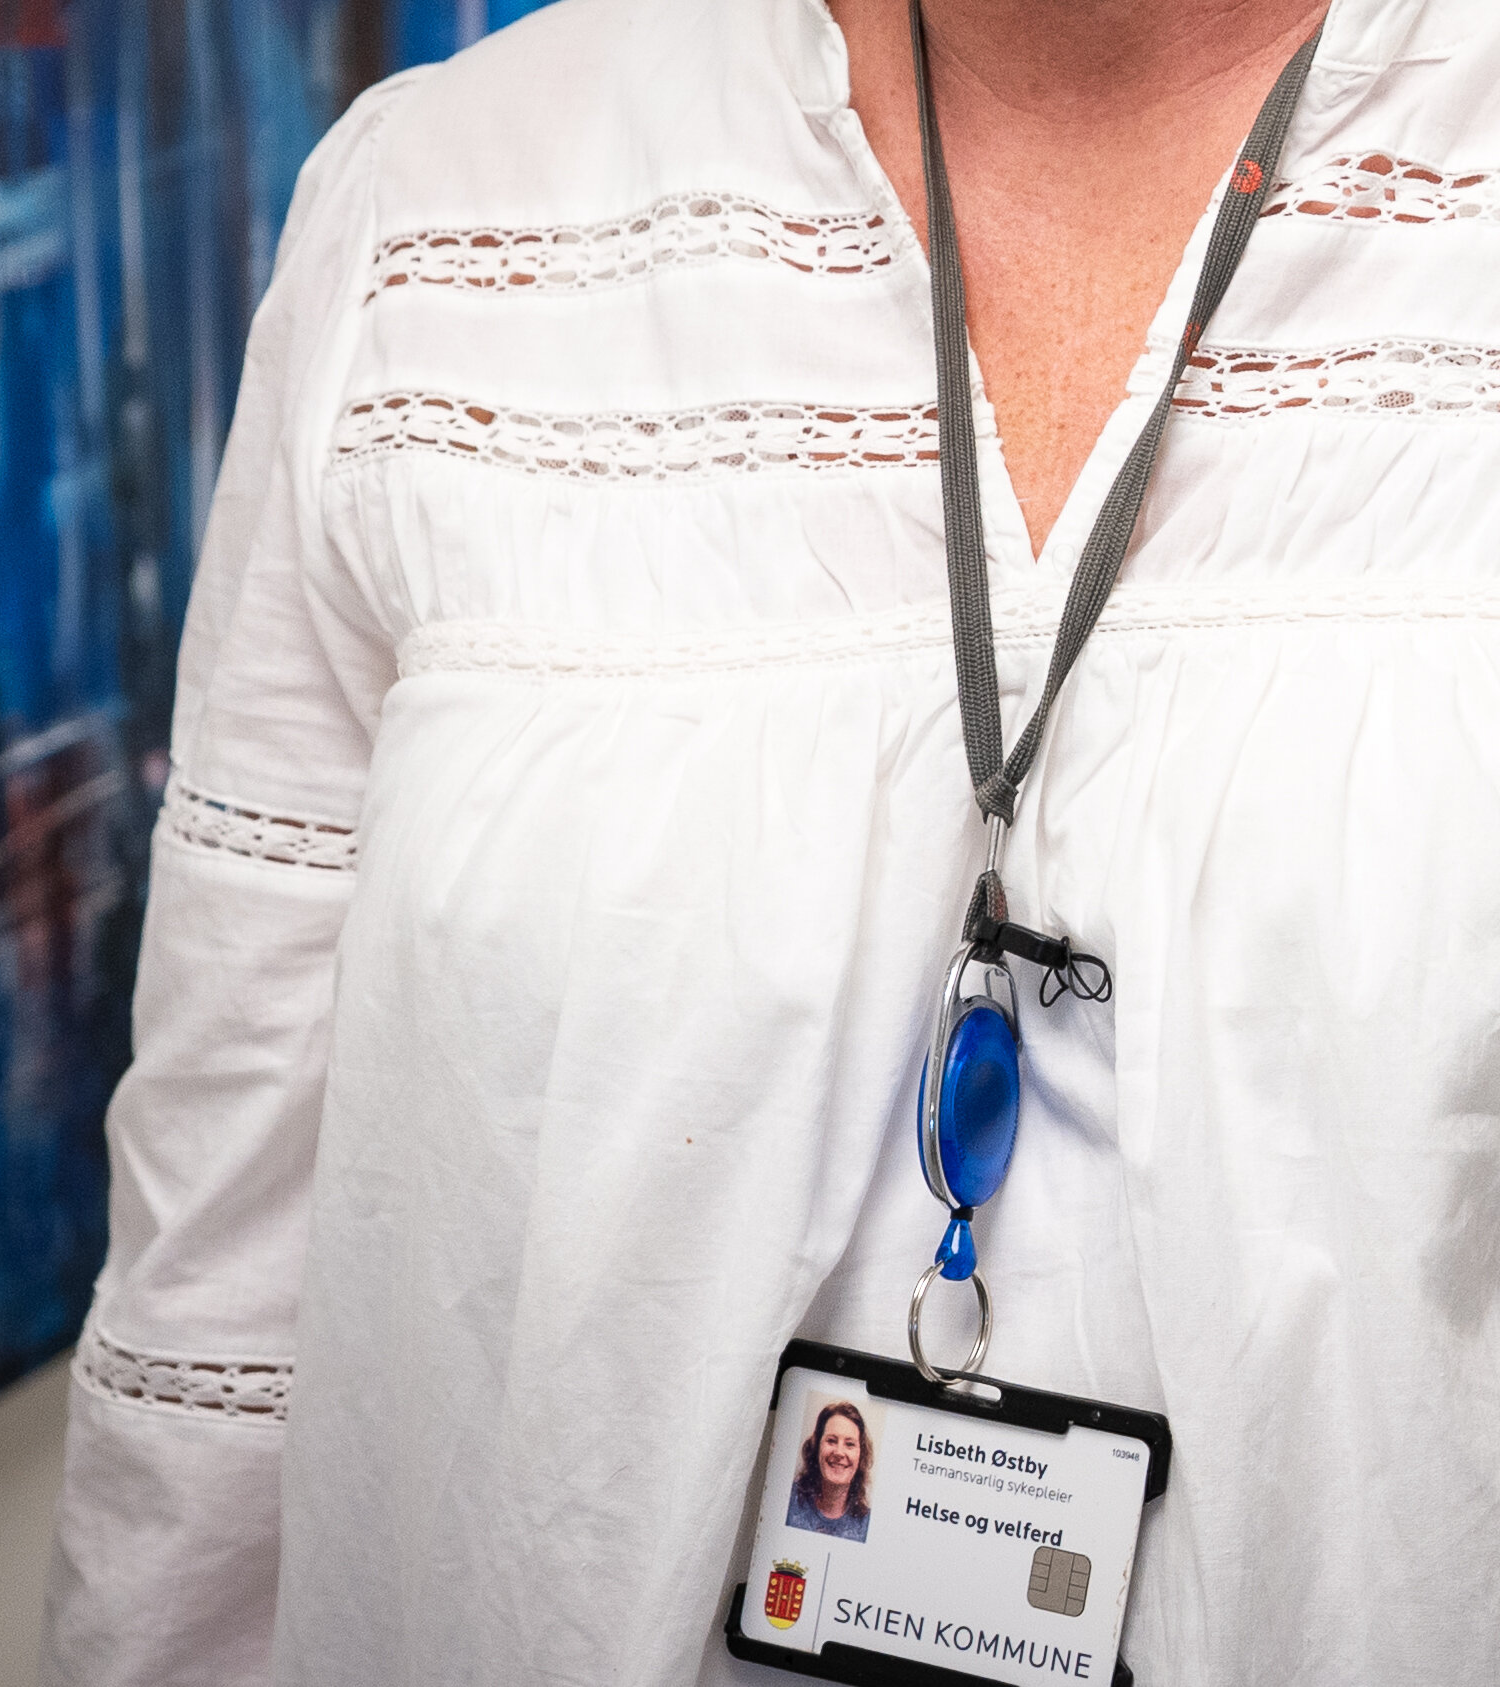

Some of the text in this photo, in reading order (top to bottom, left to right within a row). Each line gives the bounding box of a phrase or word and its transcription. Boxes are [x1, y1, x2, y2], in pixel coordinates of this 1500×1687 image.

[912, 1457, 1073, 1504] Teamansvarlig sykepleier
[916, 1433, 1048, 1480] Lisbeth Østby
[905, 1496, 1063, 1547] Helse og velferd
[833, 1598, 1093, 1680] SKIEN KOMMUNE
